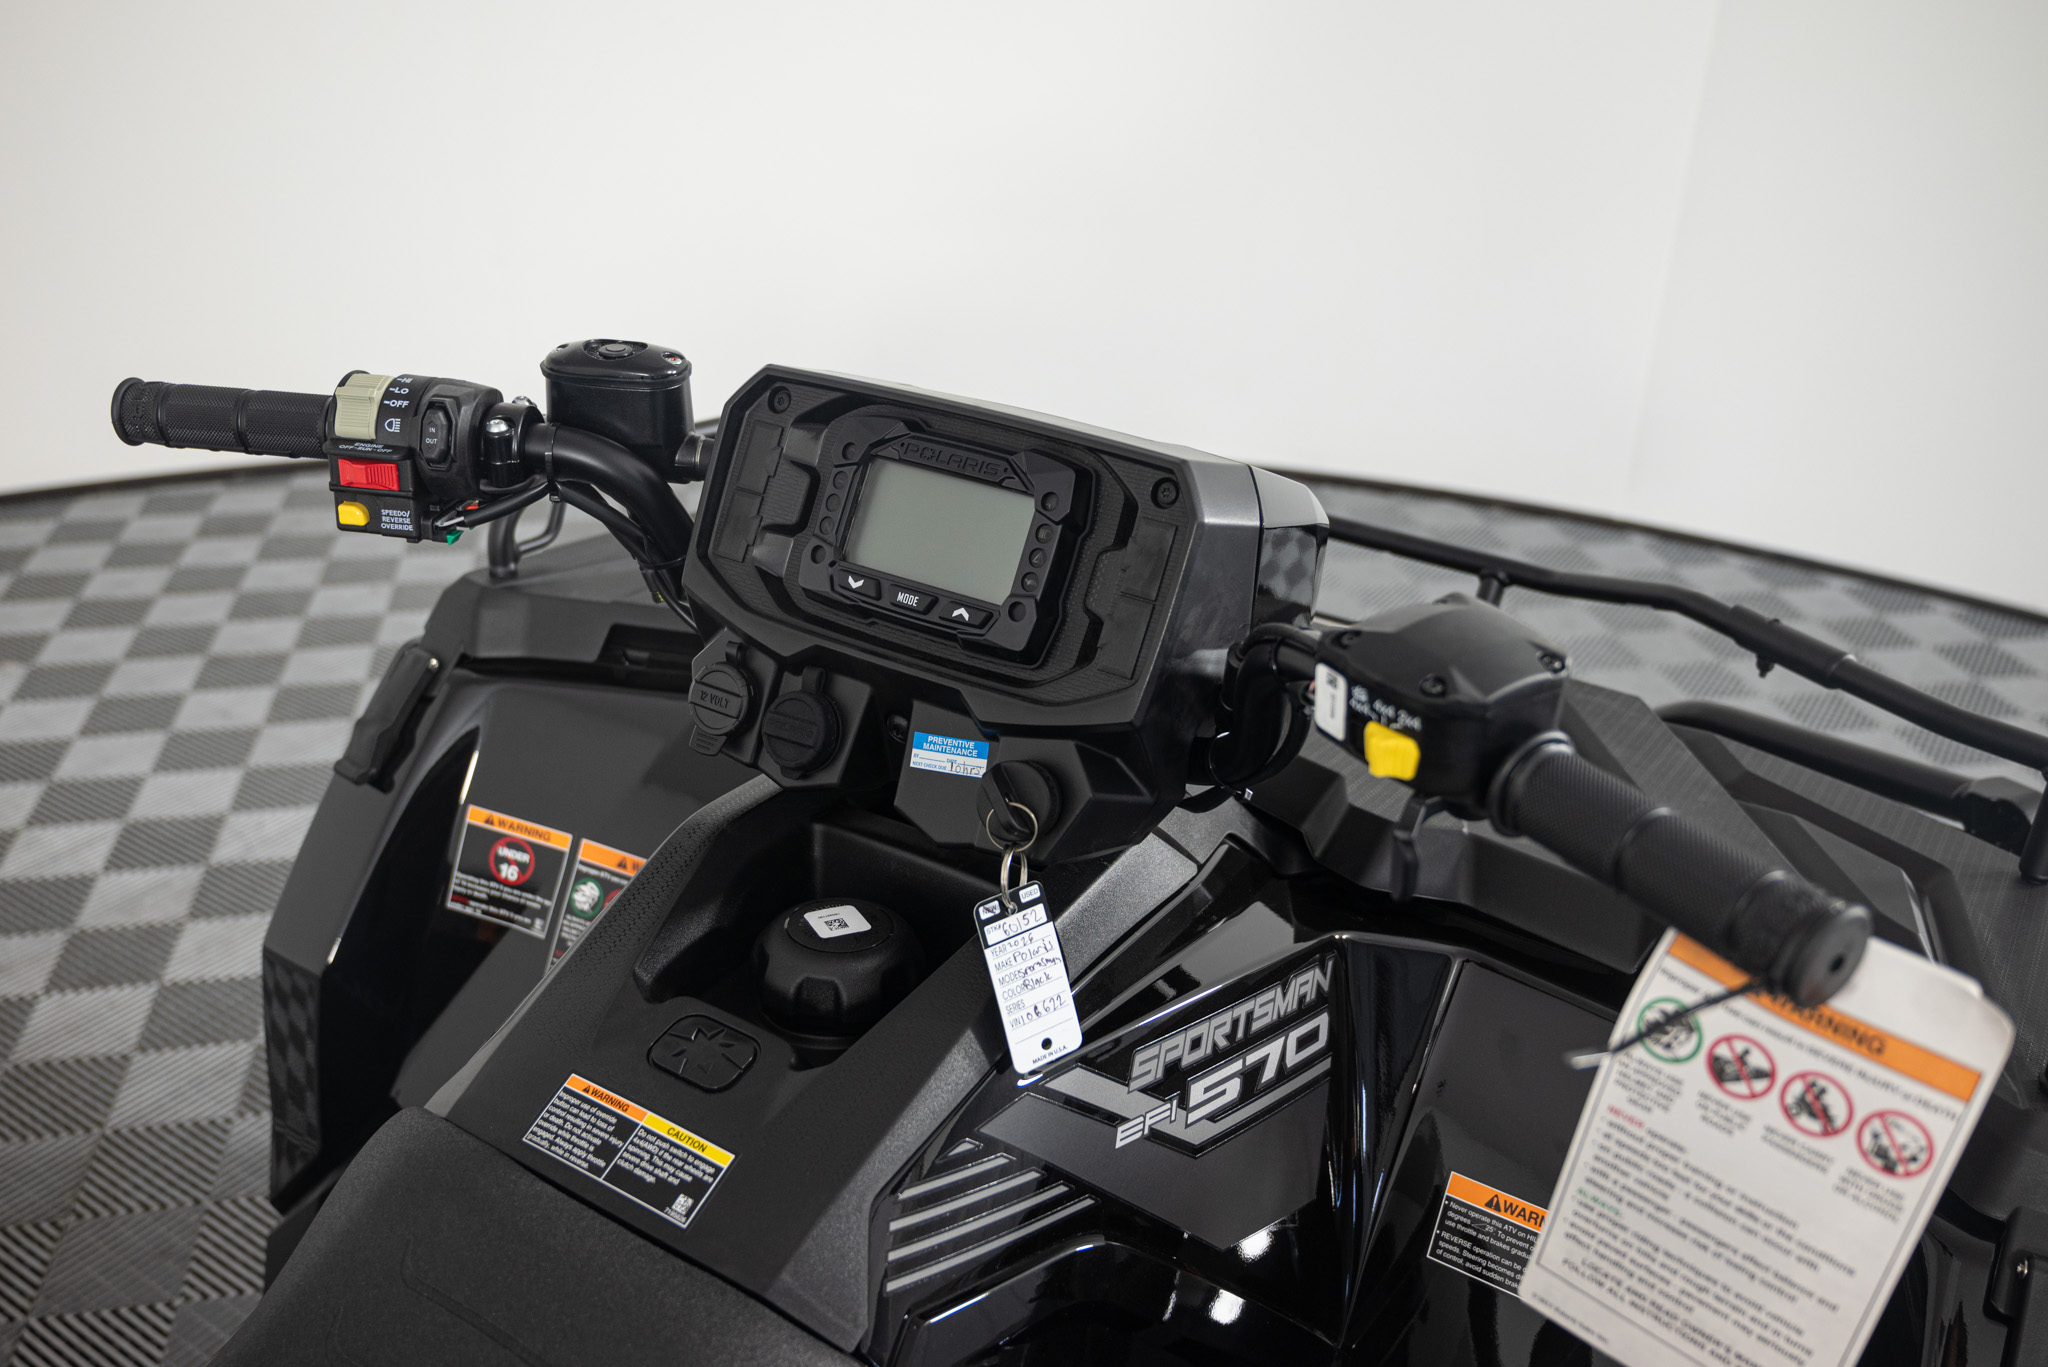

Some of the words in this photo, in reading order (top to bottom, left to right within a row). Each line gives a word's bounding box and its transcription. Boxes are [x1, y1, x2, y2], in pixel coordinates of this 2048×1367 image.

[902, 442, 1002, 476] POLARIS
[381, 509, 411, 518] SPEEDO/
[381, 516, 411, 524] REVERSE
[381, 523, 414, 531] OVERRIDE
[897, 591, 919, 607] MODE
[700, 690, 709, 700] 12
[709, 694, 731, 709] VOLT
[923, 742, 978, 757] MAINTENANCE
[927, 735, 975, 749] PREVENTIVE
[496, 817, 551, 841] WARNING
[496, 844, 531, 864] UNDER
[496, 860, 521, 883] 16
[1021, 887, 1039, 900] USED
[999, 906, 1043, 937] 60152
[989, 943, 1007, 958] YEAR
[1011, 936, 1054, 966] Polaris
[992, 956, 1014, 972] MAKE
[1021, 968, 1053, 992] Black
[1004, 998, 1026, 1015] SERIES
[1008, 1016, 1021, 1028] VIN
[1128, 957, 1335, 1093] SPORTSMAN
[1031, 1053, 1047, 1064] MADE
[1115, 1099, 1179, 1149] EFI
[1185, 1011, 1329, 1129] 570
[557, 1090, 582, 1107] Improper
[579, 1101, 591, 1111] use
[588, 1105, 598, 1114] of
[594, 1108, 618, 1124] override
[589, 1087, 630, 1112] WARNING
[563, 1121, 574, 1130] Do
[570, 1125, 583, 1135] not
[568, 1105, 580, 1115] can
[588, 1115, 598, 1124] to
[605, 1123, 615, 1132] of
[636, 1127, 648, 1138] Do
[644, 1132, 657, 1143] not
[685, 1154, 696, 1163] to
[665, 1126, 708, 1152] CAUTION
[649, 1154, 665, 1167] This
[661, 1151, 674, 1162] the
[1449, 1201, 1468, 1214] Never
[1467, 1209, 1491, 1224] operate
[1490, 1218, 1503, 1228] this
[1502, 1223, 1517, 1234] ATV
[1444, 1218, 1456, 1228] use
[1456, 1222, 1477, 1236] throttle
[1477, 1231, 1489, 1242] and
[1489, 1237, 1510, 1251] brakes
[1446, 1209, 1471, 1226] degrees
[1496, 1230, 1506, 1239] To
[1504, 1234, 1529, 1250] prevent
[1440, 1230, 1472, 1249] REVERSE
[1471, 1245, 1500, 1262] operation
[1500, 1258, 1512, 1267] can
[1512, 1262, 1521, 1271] be
[1435, 1247, 1443, 1255] of
[1464, 1260, 1482, 1273] avoid
[1481, 1268, 1505, 1282] sudden
[1461, 1248, 1488, 1267] Steering
[1486, 1260, 1515, 1277] becomes
